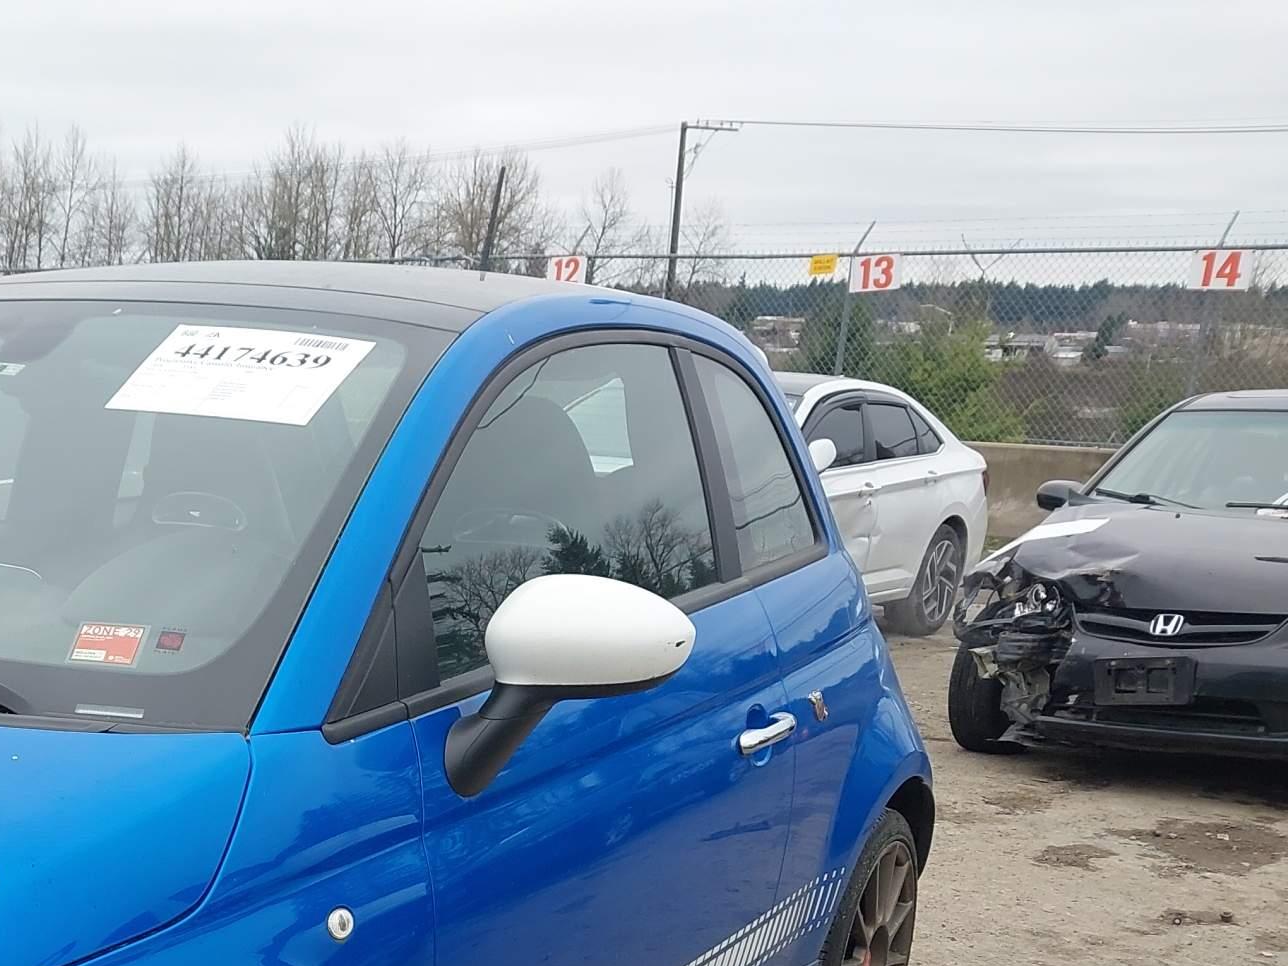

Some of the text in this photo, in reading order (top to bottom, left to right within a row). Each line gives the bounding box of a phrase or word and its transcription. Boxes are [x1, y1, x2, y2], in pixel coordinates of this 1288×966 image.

[554, 257, 580, 282] 12
[860, 255, 895, 289] 13
[1201, 251, 1242, 287] 14
[174, 343, 332, 369] 44174639
